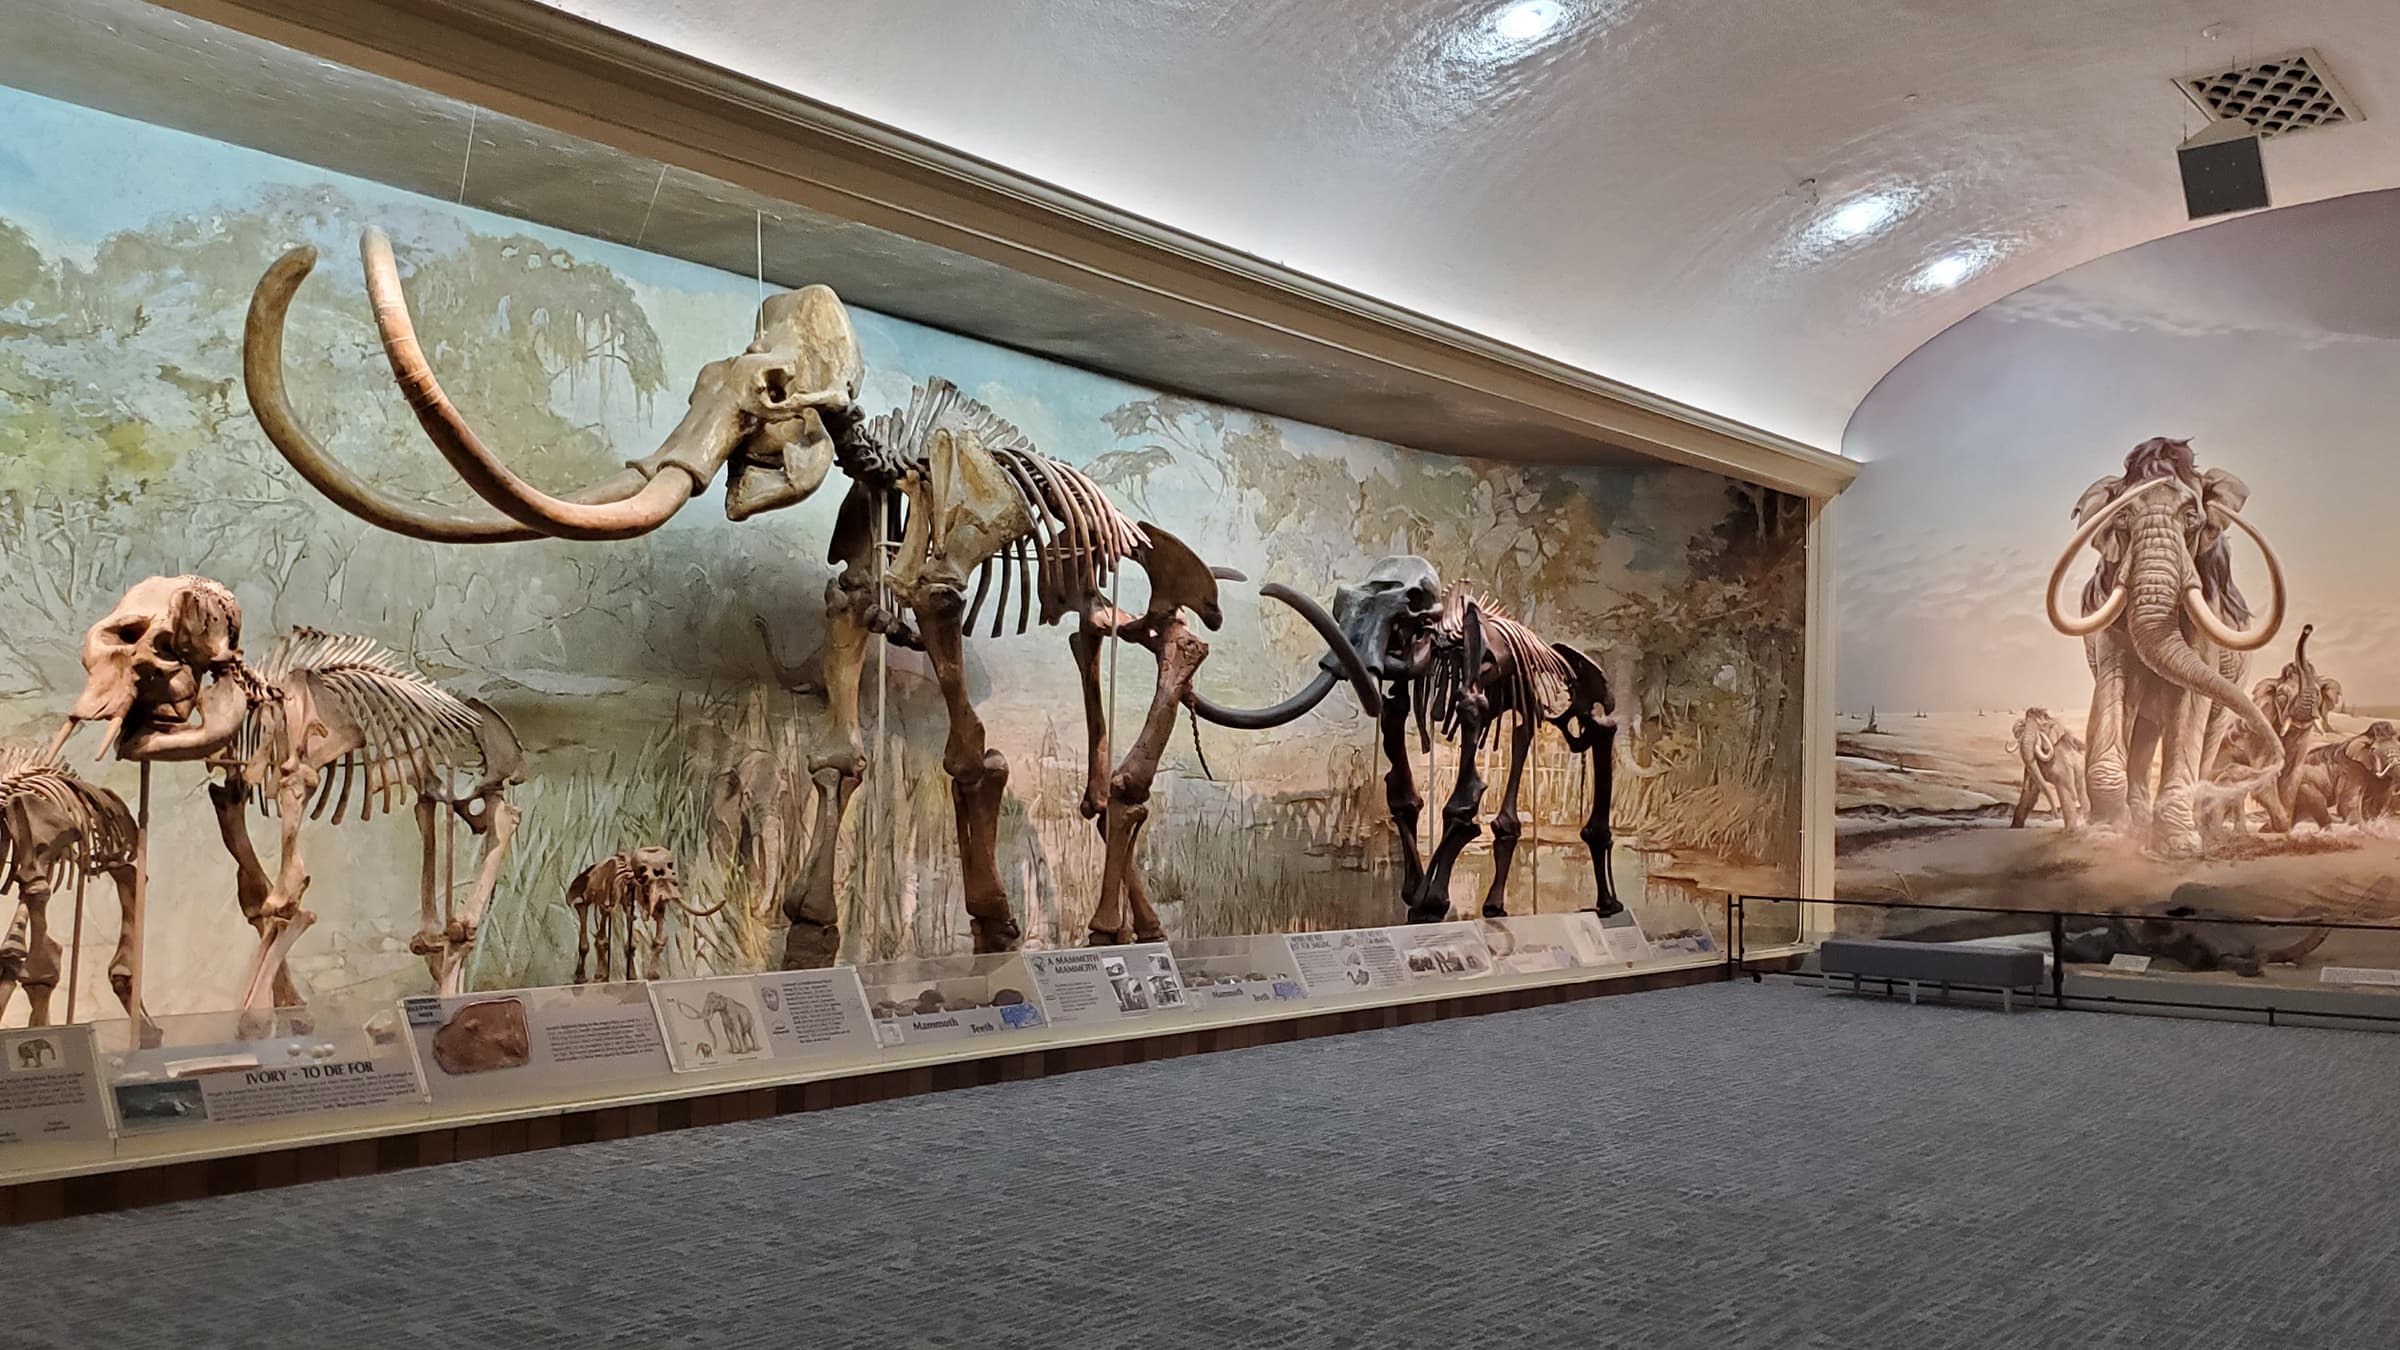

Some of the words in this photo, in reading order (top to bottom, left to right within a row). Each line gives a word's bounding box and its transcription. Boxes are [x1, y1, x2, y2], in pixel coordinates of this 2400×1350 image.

[1047, 957, 1054, 966] A
[1055, 954, 1099, 964] MAMMOTH
[1055, 963, 1098, 974] MAMMOTH
[913, 1017, 959, 1031] Mammoth
[970, 1022, 994, 1034] Teeth
[245, 1070, 287, 1085] IVORY
[301, 1065, 320, 1079] TO
[324, 1063, 345, 1077] DIE
[348, 1060, 374, 1074] FOR
